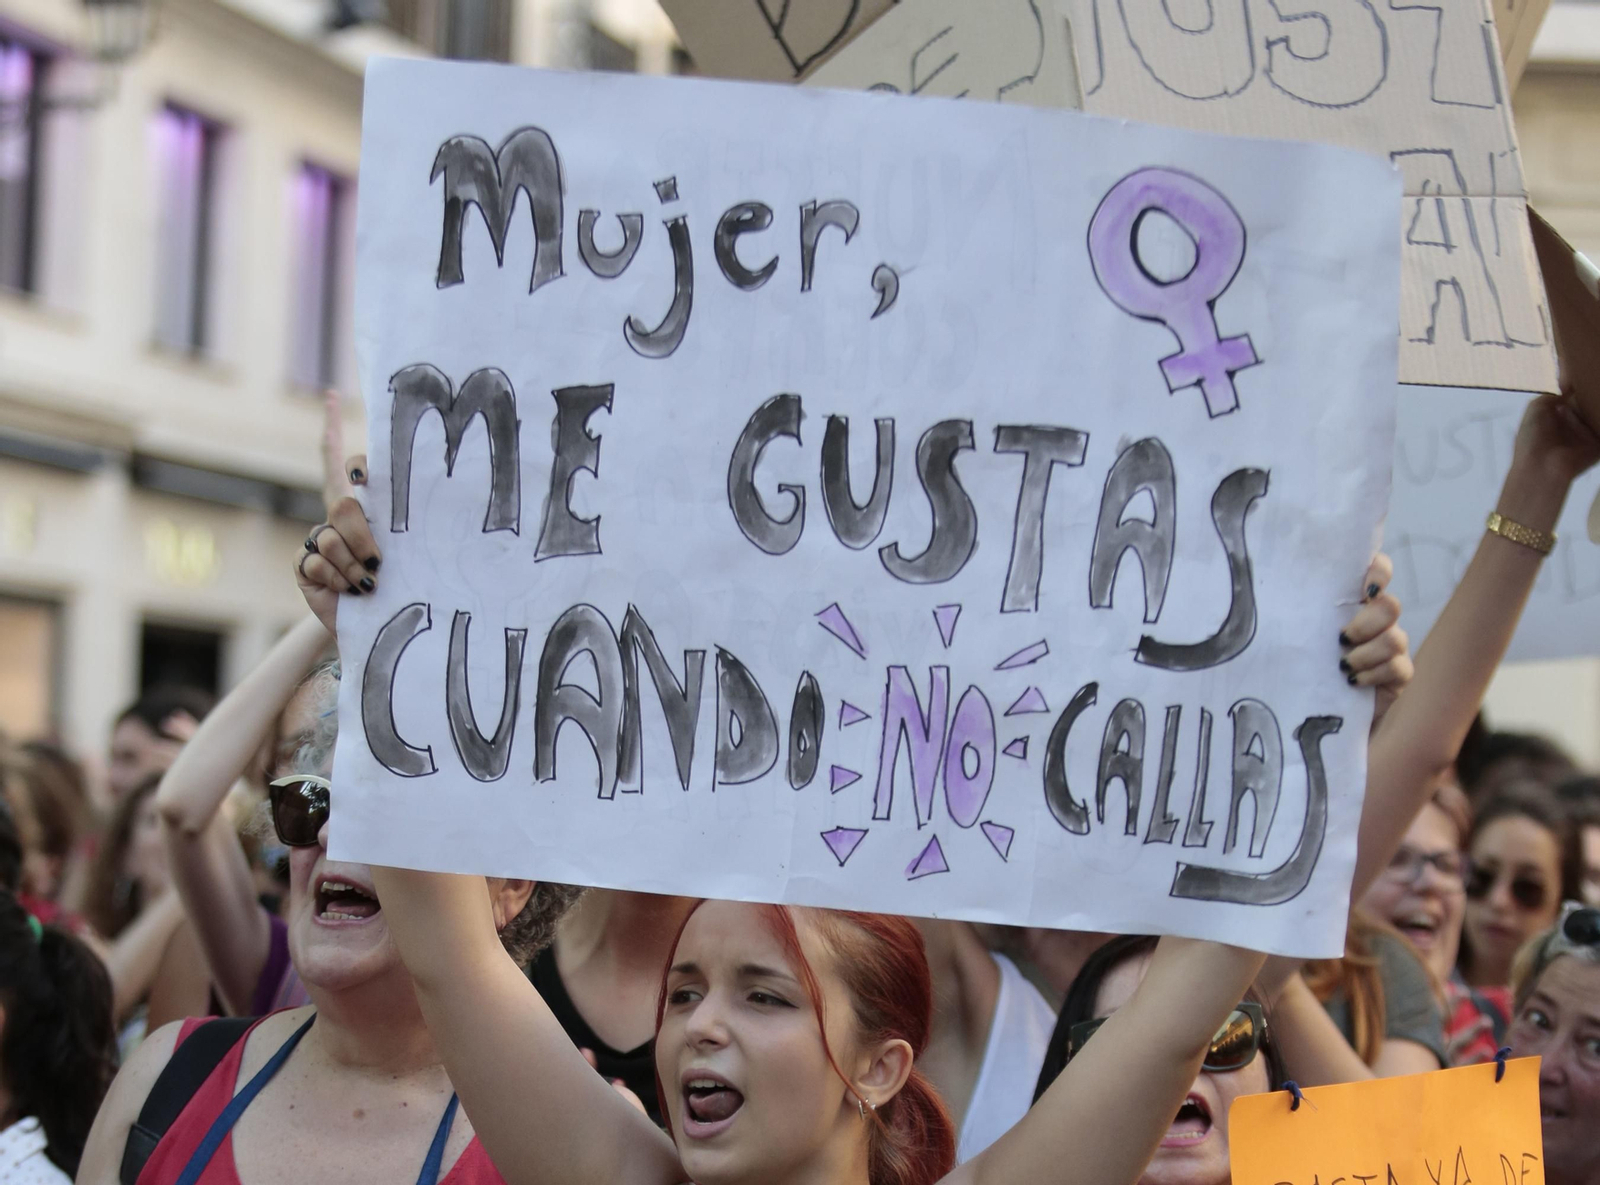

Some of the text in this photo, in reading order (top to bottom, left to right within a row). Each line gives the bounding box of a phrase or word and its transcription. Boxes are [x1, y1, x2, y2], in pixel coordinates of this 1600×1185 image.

[428, 125, 900, 359] Mujer,
[388, 364, 1271, 672] ME GUSTAS
[360, 602, 1344, 906] CUANDO NO CALLAS
